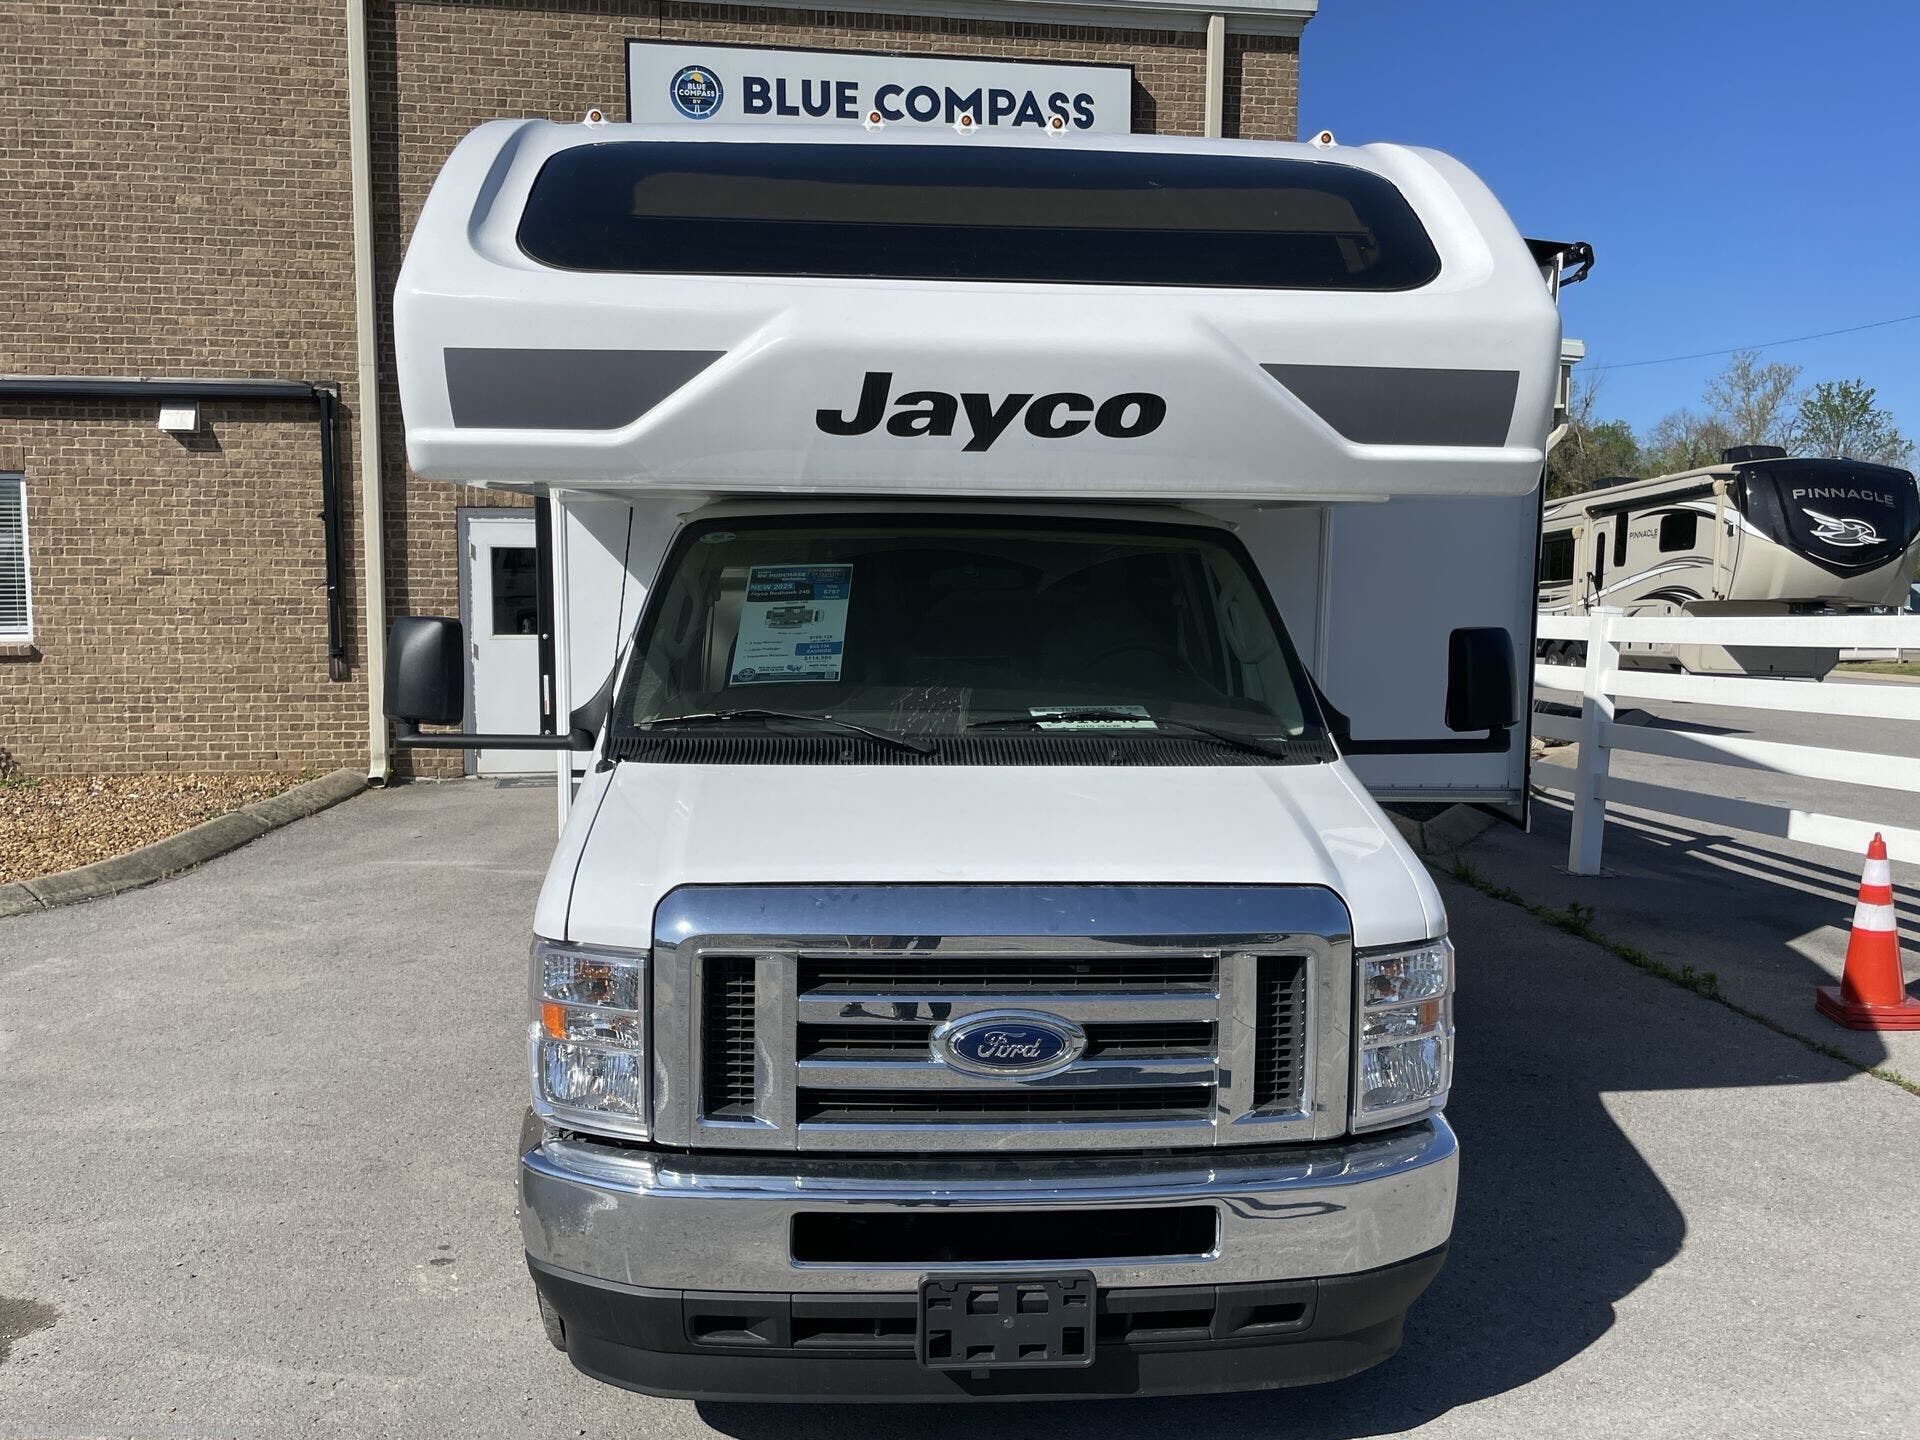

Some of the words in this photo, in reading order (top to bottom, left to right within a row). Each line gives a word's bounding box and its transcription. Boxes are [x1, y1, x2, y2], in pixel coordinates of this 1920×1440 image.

[678, 89, 715, 97] COMPASS
[742, 76, 859, 119] BLUE
[873, 83, 1095, 130] COMPASS
[815, 371, 1167, 452] Jayco
[1792, 488, 1895, 505] PINNACLE
[1629, 527, 1658, 540] PINNACLE
[977, 1031, 1041, 1058] Ford
